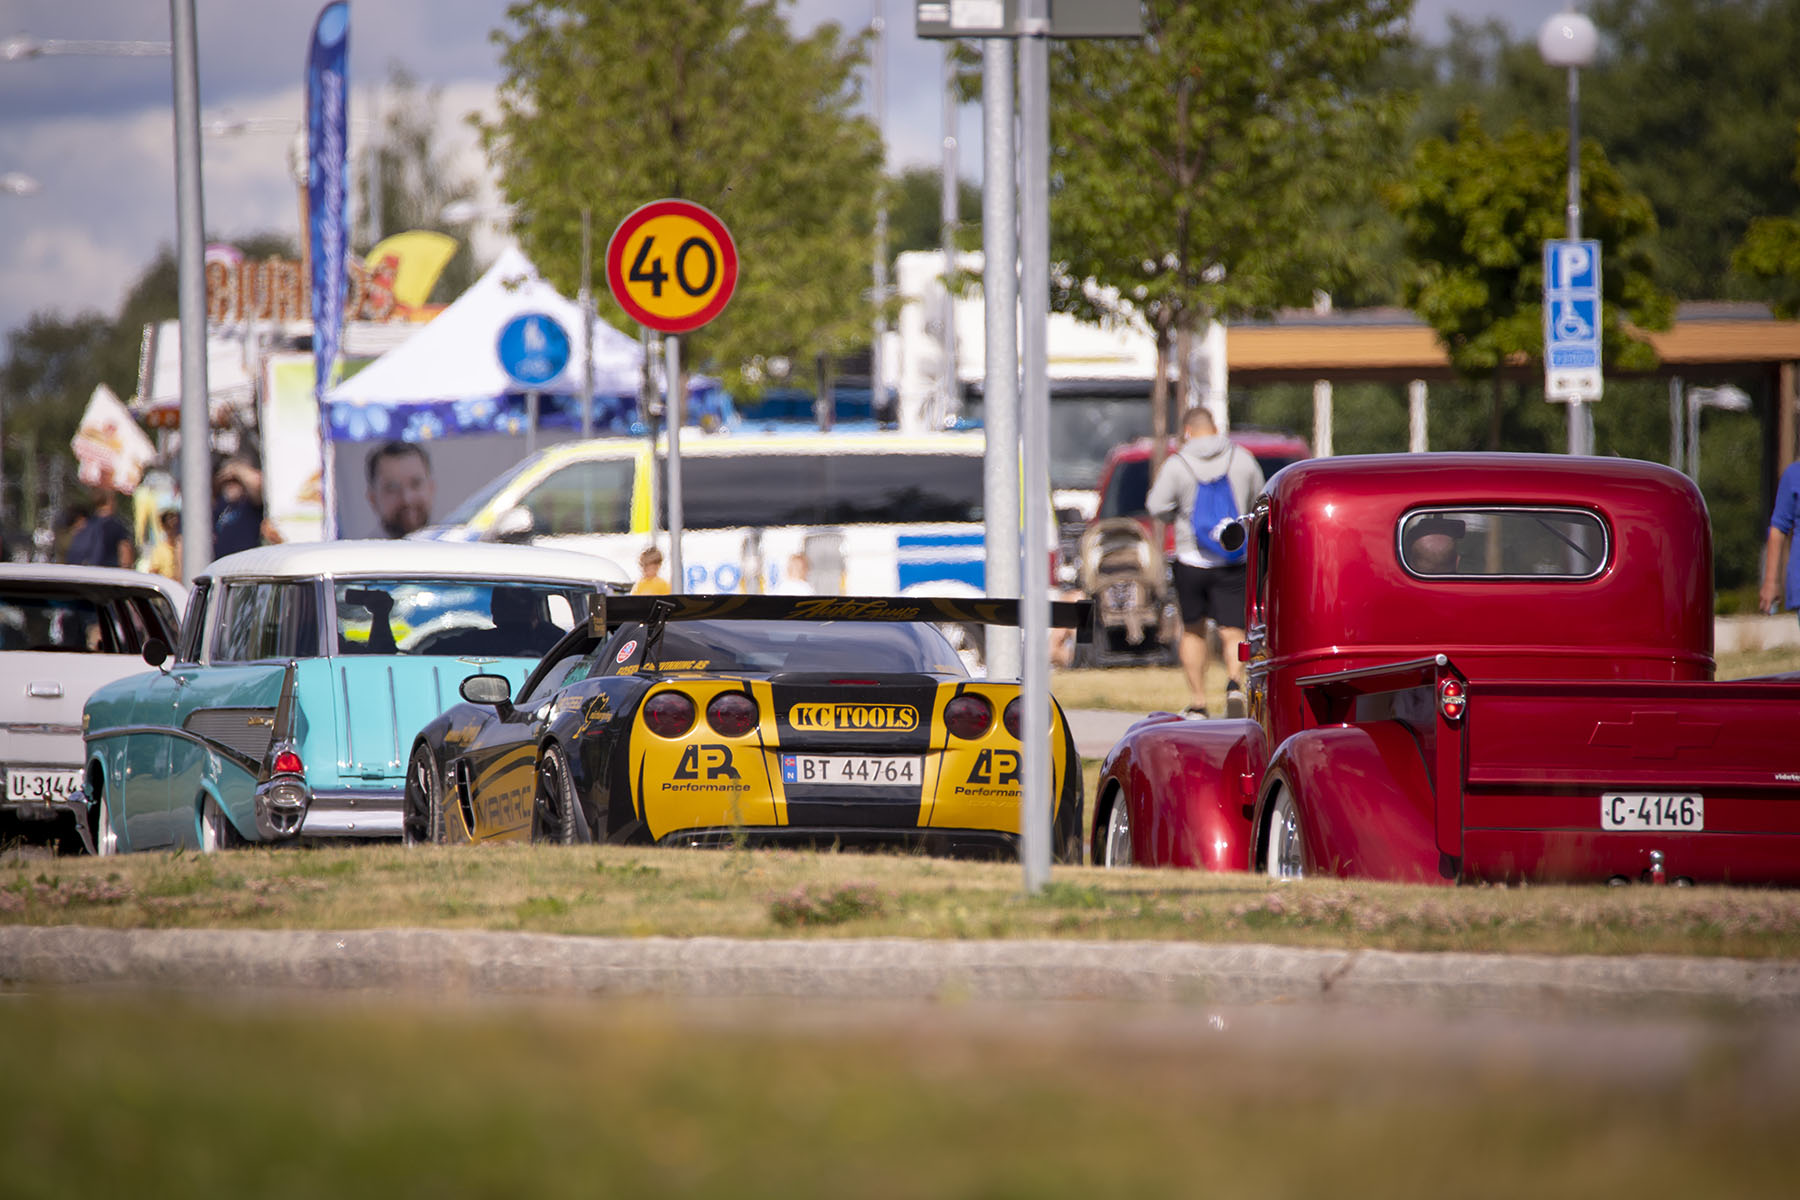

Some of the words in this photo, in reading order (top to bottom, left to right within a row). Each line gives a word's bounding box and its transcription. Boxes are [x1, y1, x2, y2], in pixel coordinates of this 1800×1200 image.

[628, 235, 717, 298] 40
[1558, 245, 1590, 289] P
[796, 706, 831, 727] KC
[835, 706, 915, 729] TOOLS
[803, 759, 831, 780] BT
[841, 759, 914, 782] 44764
[661, 782, 751, 793] Performance
[954, 786, 1024, 798] Performan
[1610, 796, 1695, 827] C-4146
